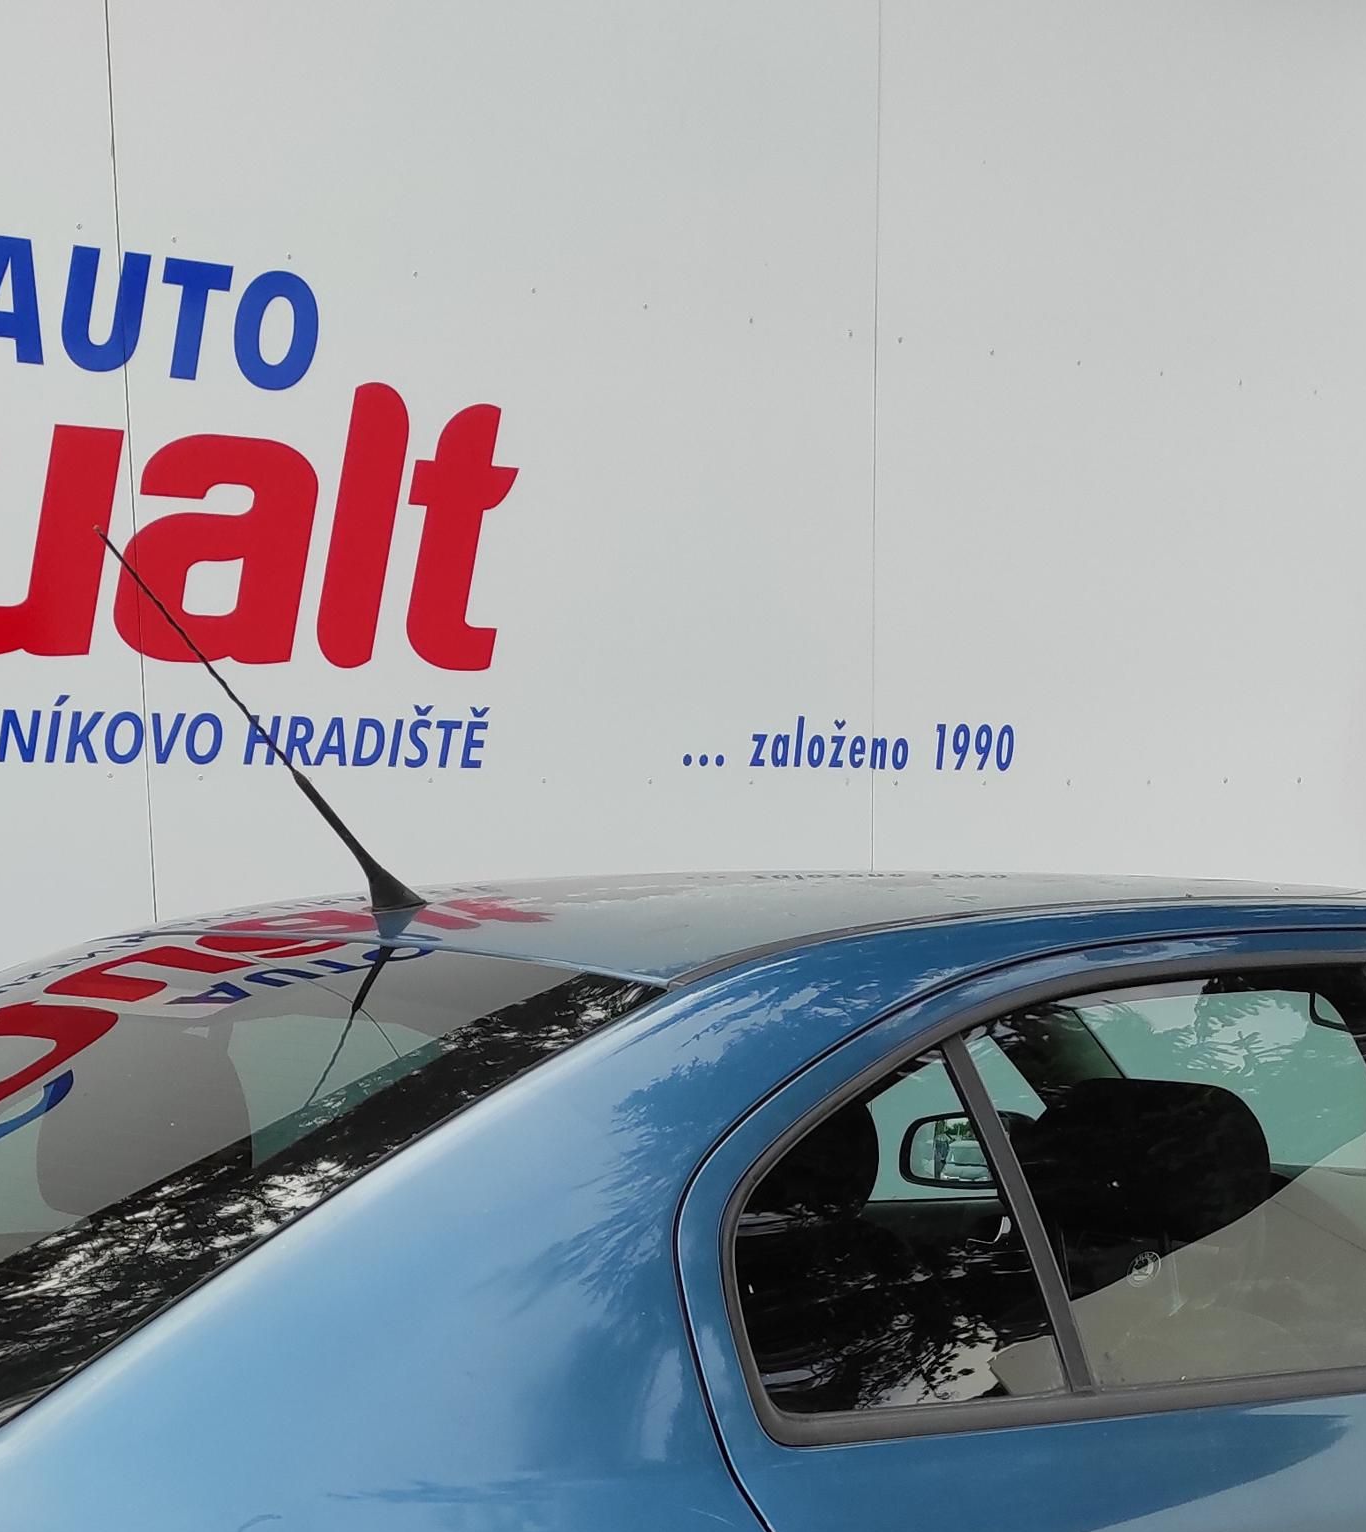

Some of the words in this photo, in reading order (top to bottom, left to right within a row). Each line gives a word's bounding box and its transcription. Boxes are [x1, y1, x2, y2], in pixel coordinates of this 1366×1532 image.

[242, 704, 492, 769] HRADIŠTĚ
[749, 715, 910, 770] založeno
[934, 723, 1015, 771] 1990
